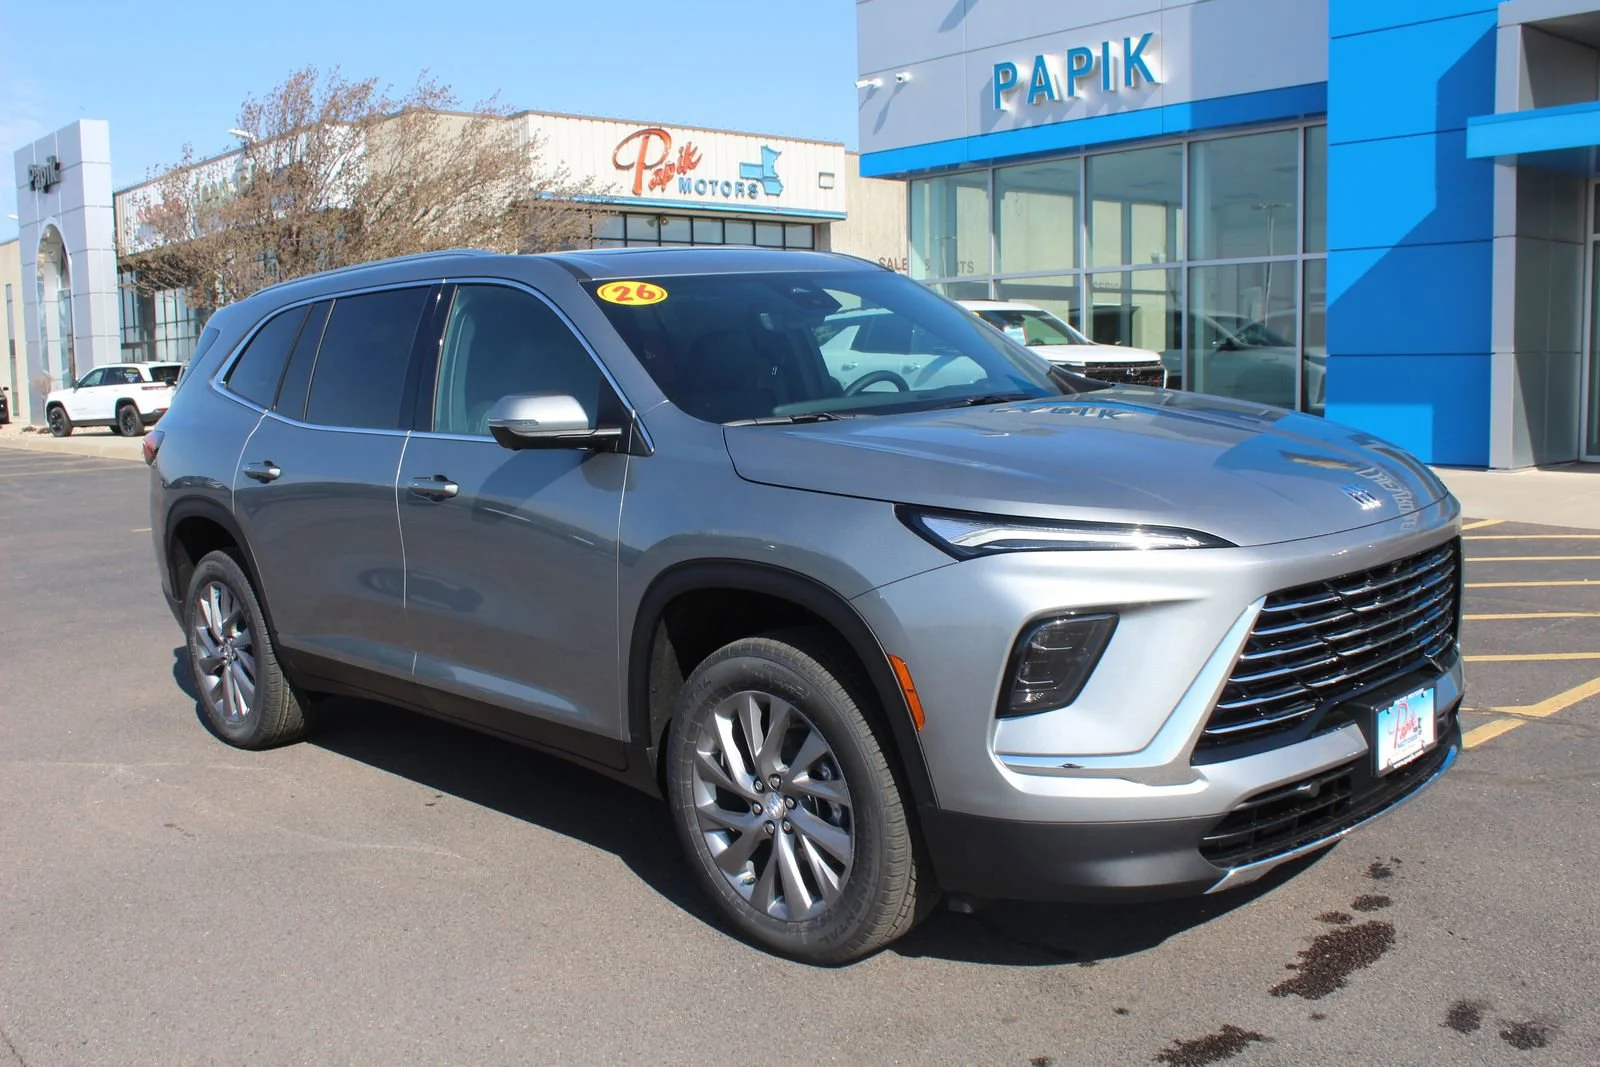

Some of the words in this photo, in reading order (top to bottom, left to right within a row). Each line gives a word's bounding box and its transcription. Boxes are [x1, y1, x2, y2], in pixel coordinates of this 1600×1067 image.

[990, 32, 1158, 111] PAPIK
[612, 128, 702, 196] Papik
[678, 177, 758, 199] MOTORS
[879, 257, 908, 271] SALE
[612, 284, 656, 301] 26
